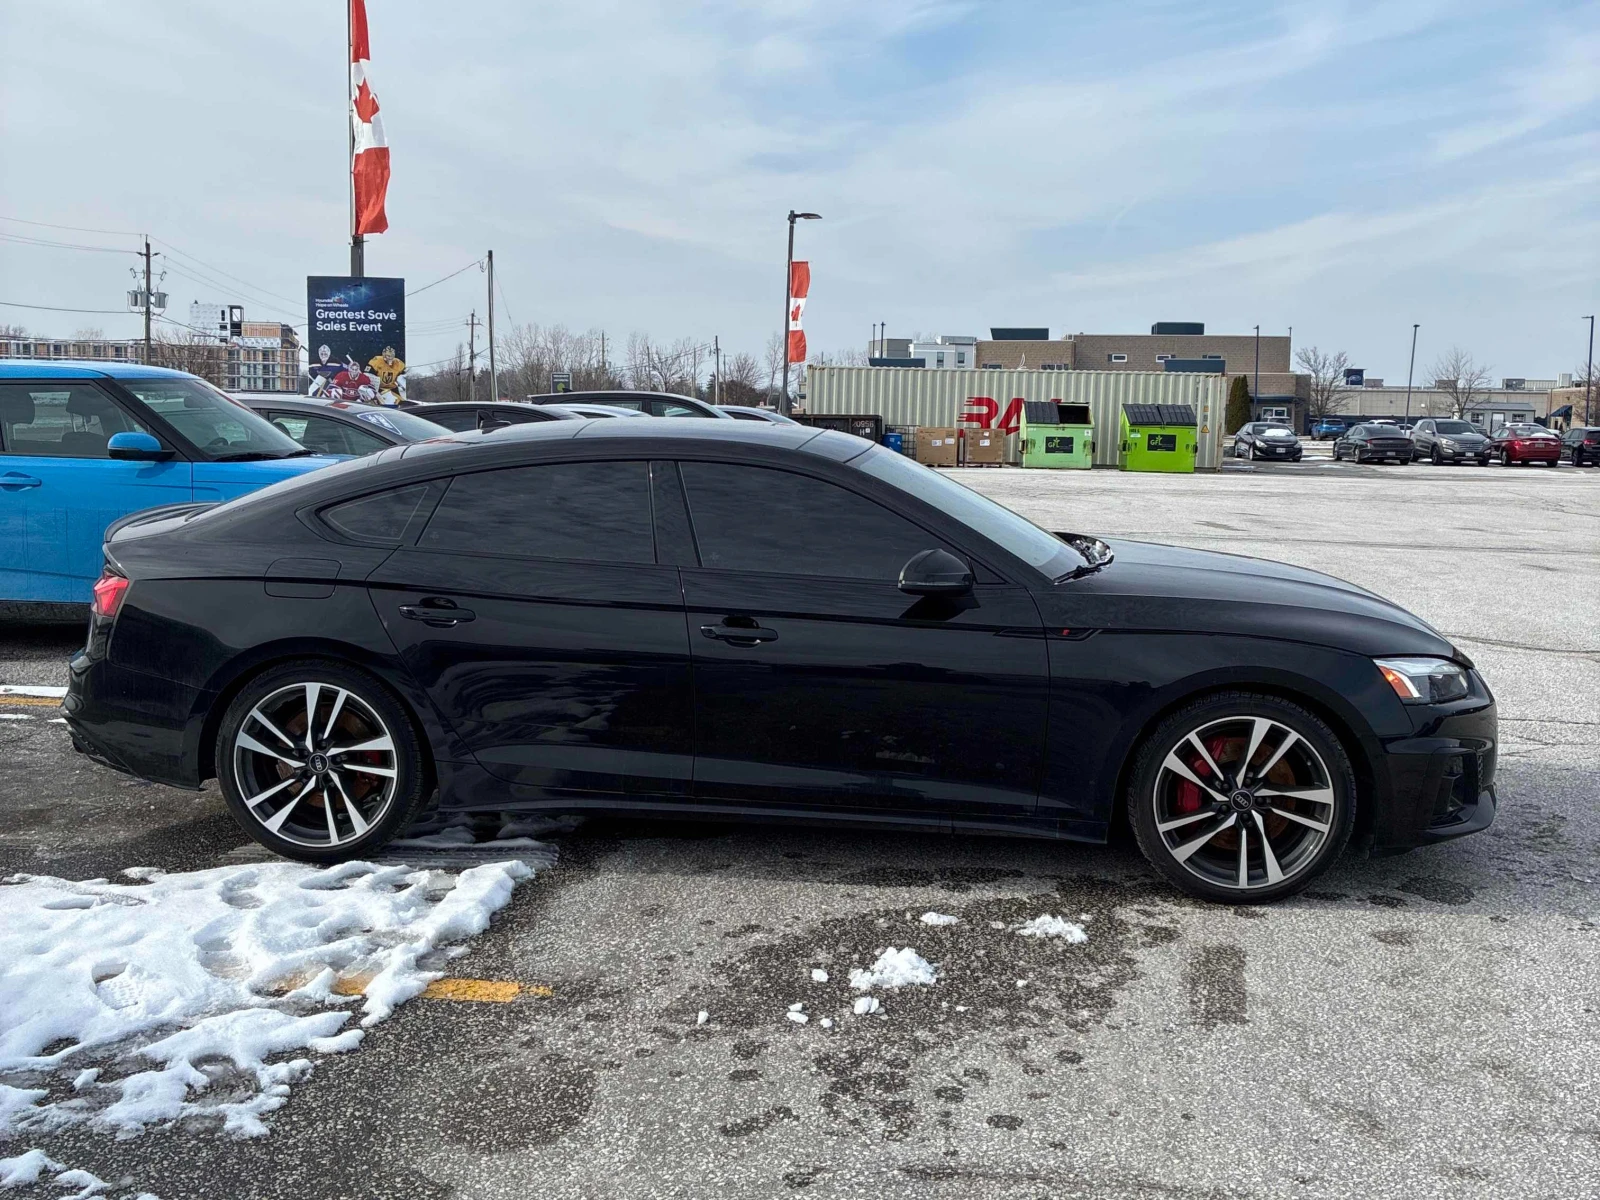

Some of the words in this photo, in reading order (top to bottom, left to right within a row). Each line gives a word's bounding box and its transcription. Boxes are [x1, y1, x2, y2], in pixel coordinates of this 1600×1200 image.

[316, 309, 365, 319] Greatest
[367, 310, 397, 320] Save
[316, 321, 347, 331] Sales
[349, 322, 382, 332] Event
